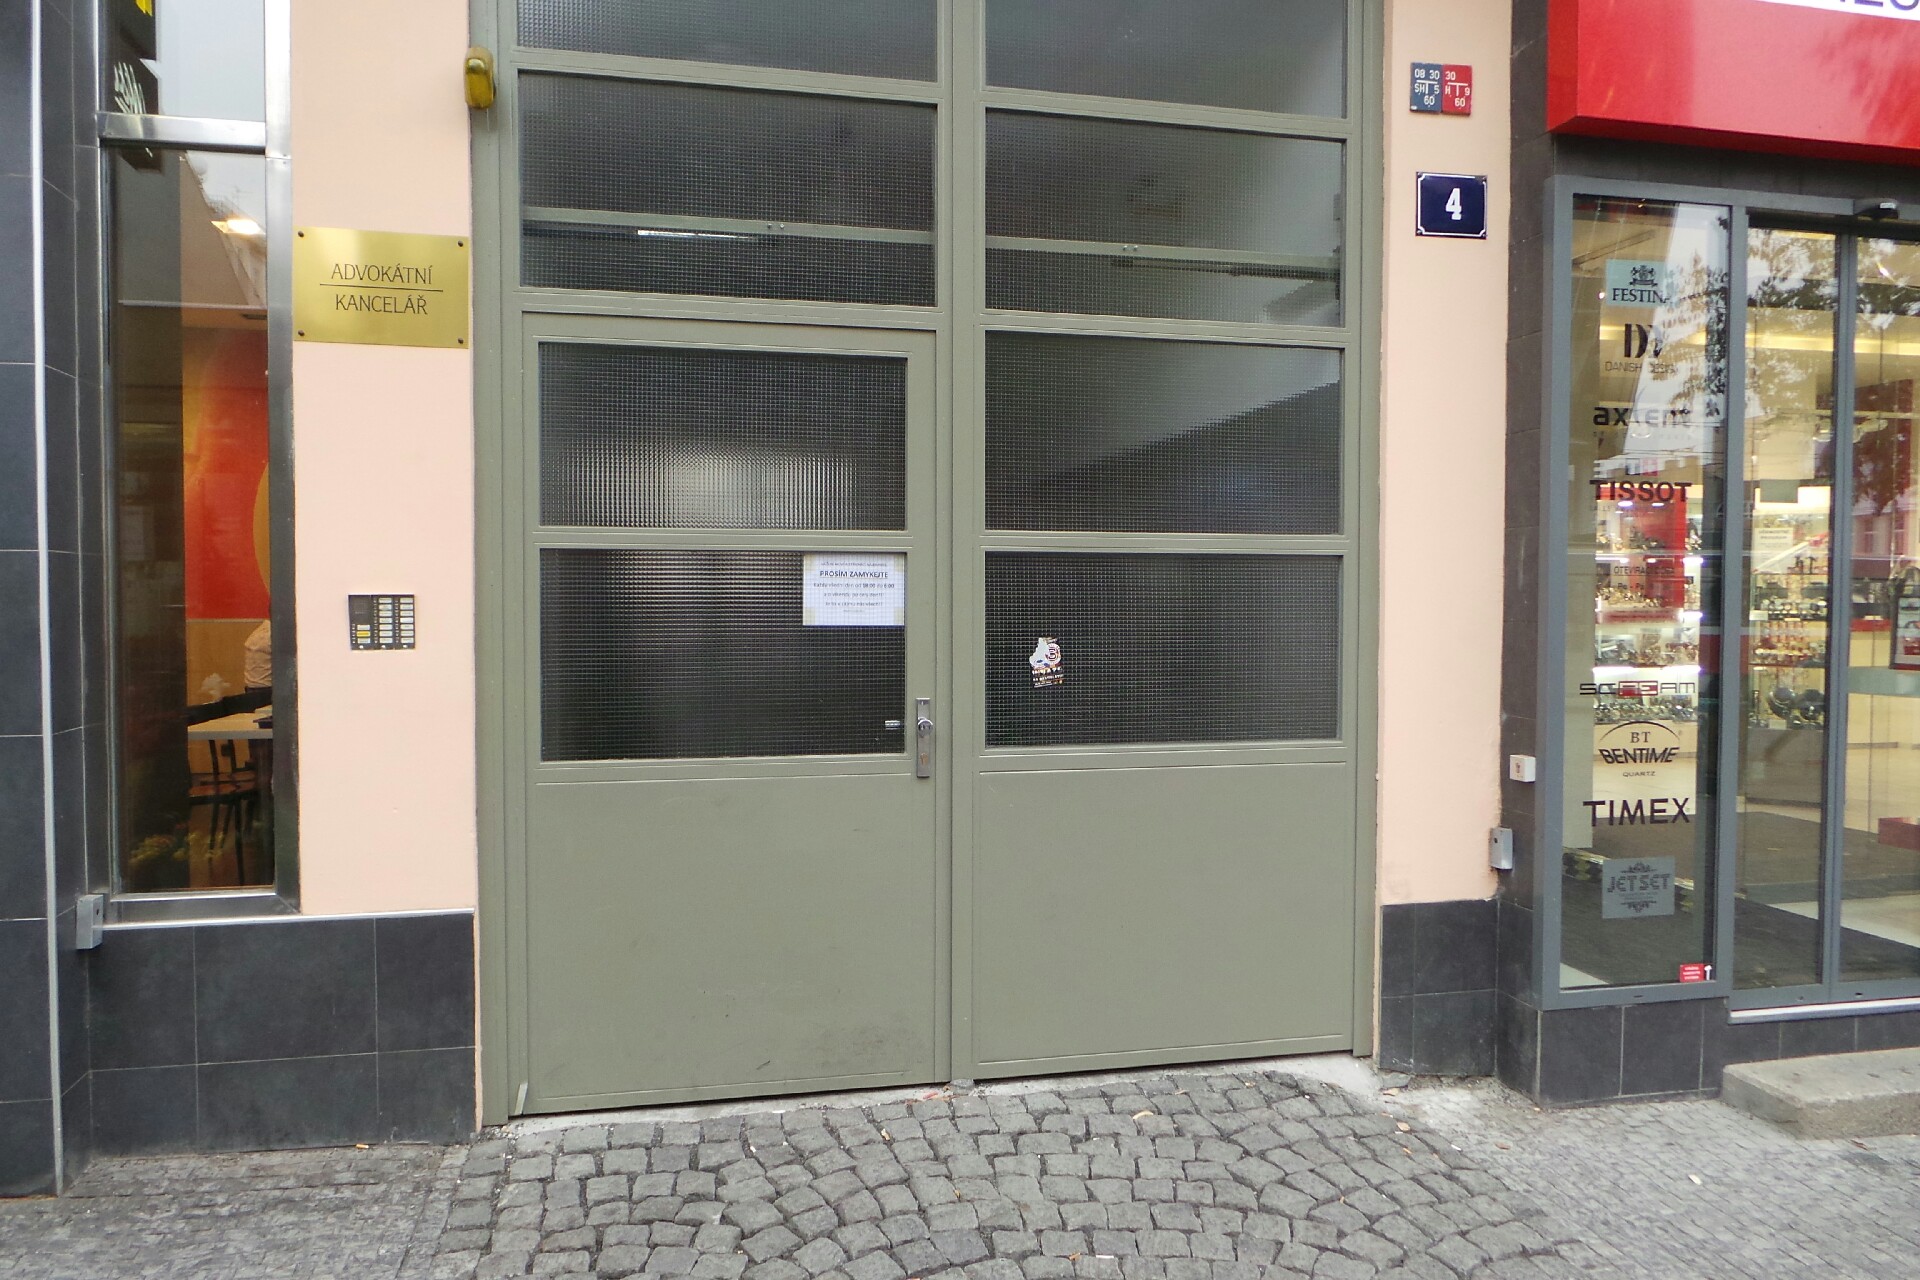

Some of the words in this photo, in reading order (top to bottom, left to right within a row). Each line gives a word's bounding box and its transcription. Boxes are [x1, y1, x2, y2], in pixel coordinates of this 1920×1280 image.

[1429, 69, 1440, 80] 30
[1445, 71, 1456, 81] 30
[1434, 84, 1440, 94] 5
[1423, 95, 1435, 106] 60
[1454, 97, 1466, 107] 60
[1445, 188, 1462, 220] 4
[331, 263, 433, 285] ADVOKÁTNÍ
[1612, 288, 1670, 304] FESTIN
[335, 294, 428, 315] KANCELÁŘ
[1589, 479, 1692, 502] TISSOT
[820, 569, 848, 577] PROSÍM
[1630, 731, 1651, 744] BT
[1598, 747, 1680, 765] BENTIME
[1622, 770, 1656, 778] QUARTZ
[1583, 797, 1690, 827] TIMEX
